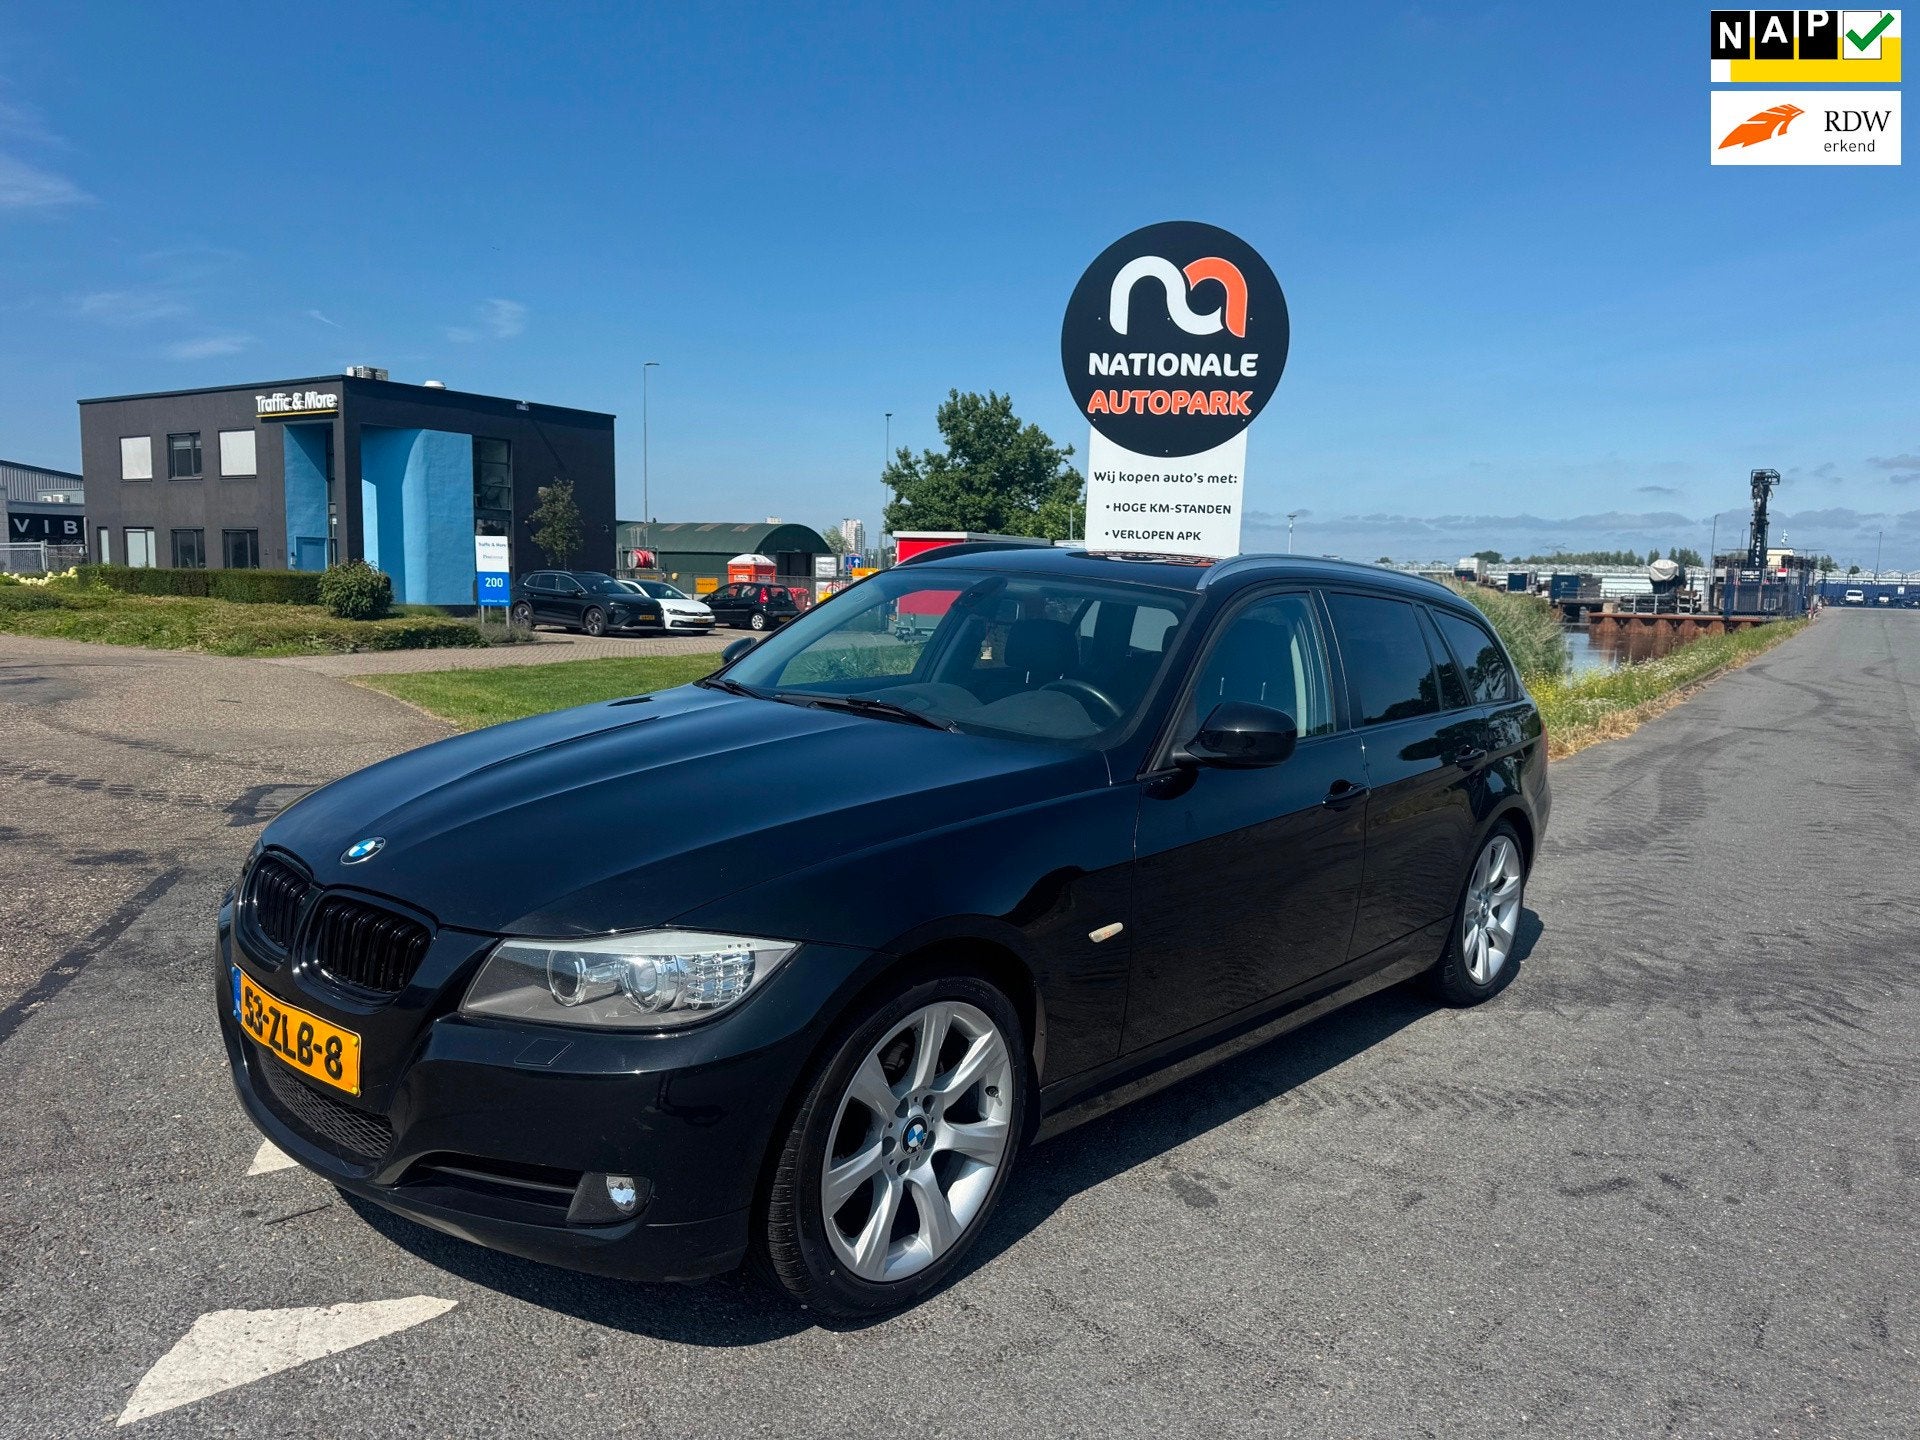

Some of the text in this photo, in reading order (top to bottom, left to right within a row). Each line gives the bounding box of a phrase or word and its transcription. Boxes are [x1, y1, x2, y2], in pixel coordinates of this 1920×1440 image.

[1088, 352, 1258, 377] NATIONALE
[255, 391, 338, 412] Traffic & More
[1087, 389, 1253, 415] AUTOPARK
[1094, 471, 1237, 484] Wij kopen auto's met:
[1113, 503, 1232, 514] HOGE KM-STANDEN
[13, 518, 79, 535] VIB
[1112, 530, 1202, 540] VERLOPEN APK
[485, 577, 503, 588] 200
[244, 985, 343, 1080] 53-ZLB-8
